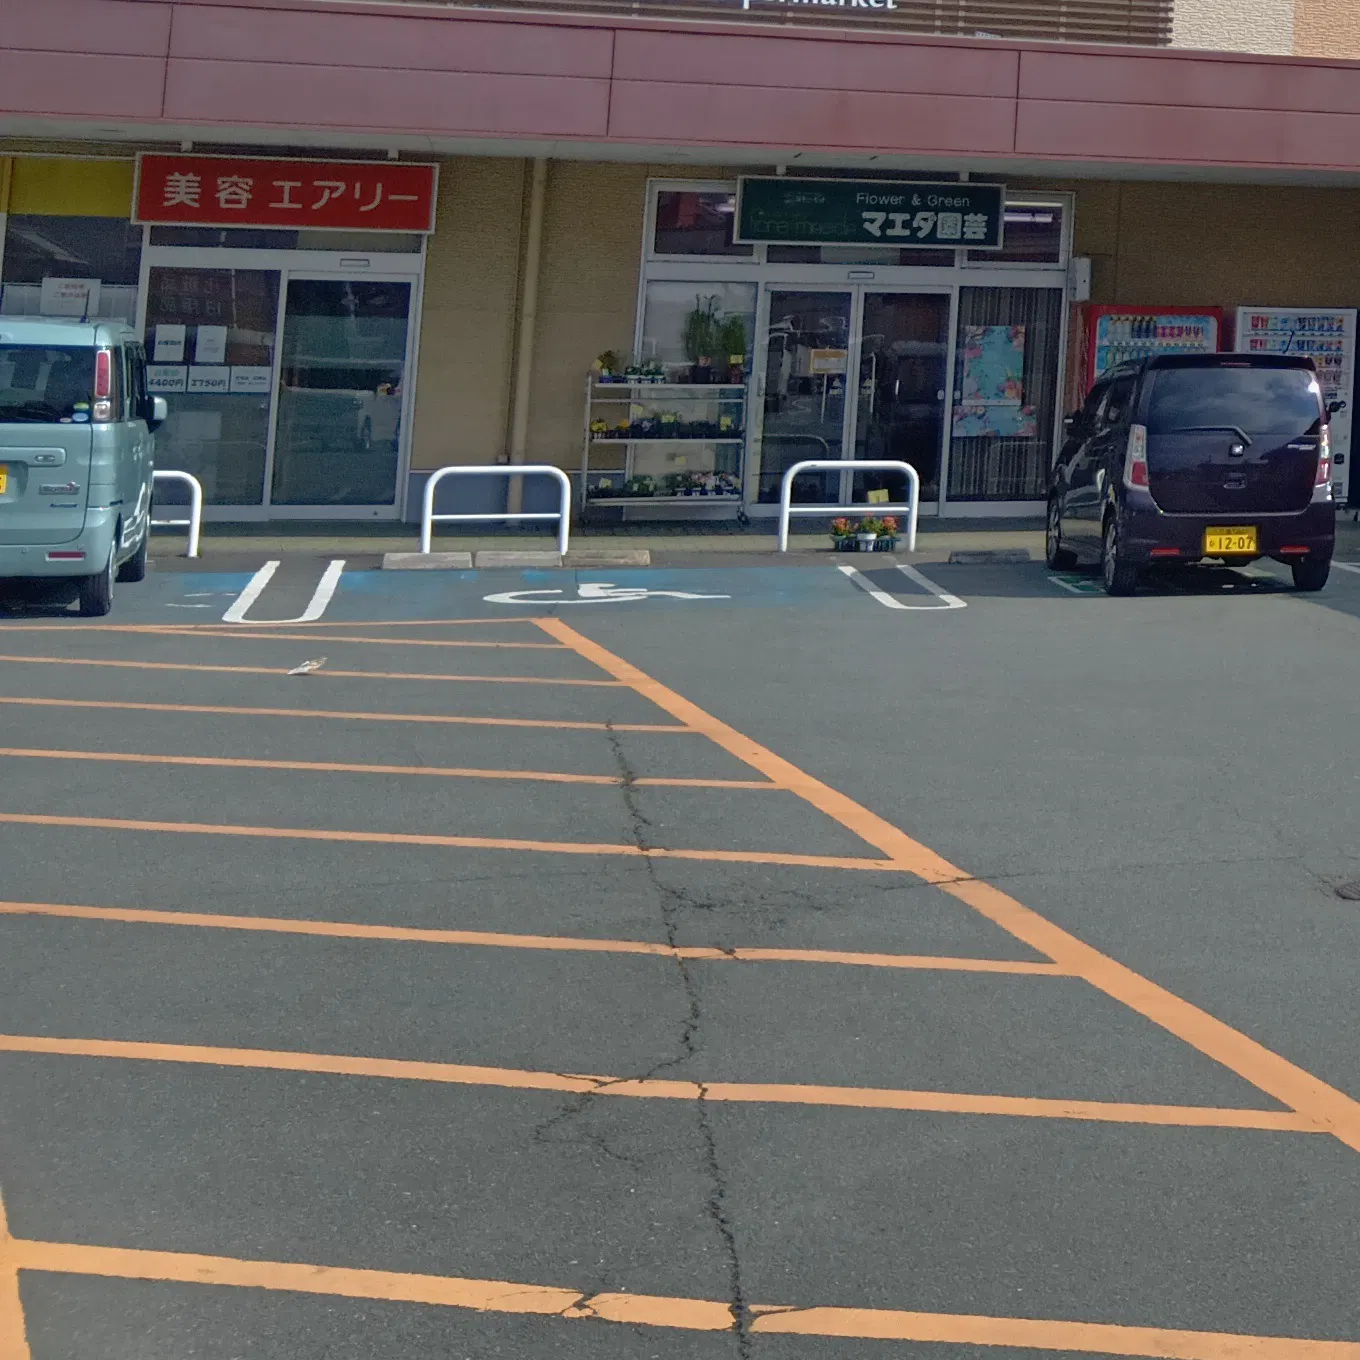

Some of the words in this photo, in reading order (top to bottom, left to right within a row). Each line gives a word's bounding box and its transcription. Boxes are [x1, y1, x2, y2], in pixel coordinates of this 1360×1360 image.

[162, 171, 254, 209] 美容
[268, 180, 419, 212] エアリー
[856, 192, 906, 206] Flower
[911, 193, 922, 206] &
[927, 194, 970, 208] Green
[861, 211, 989, 240] マエダ園芸
